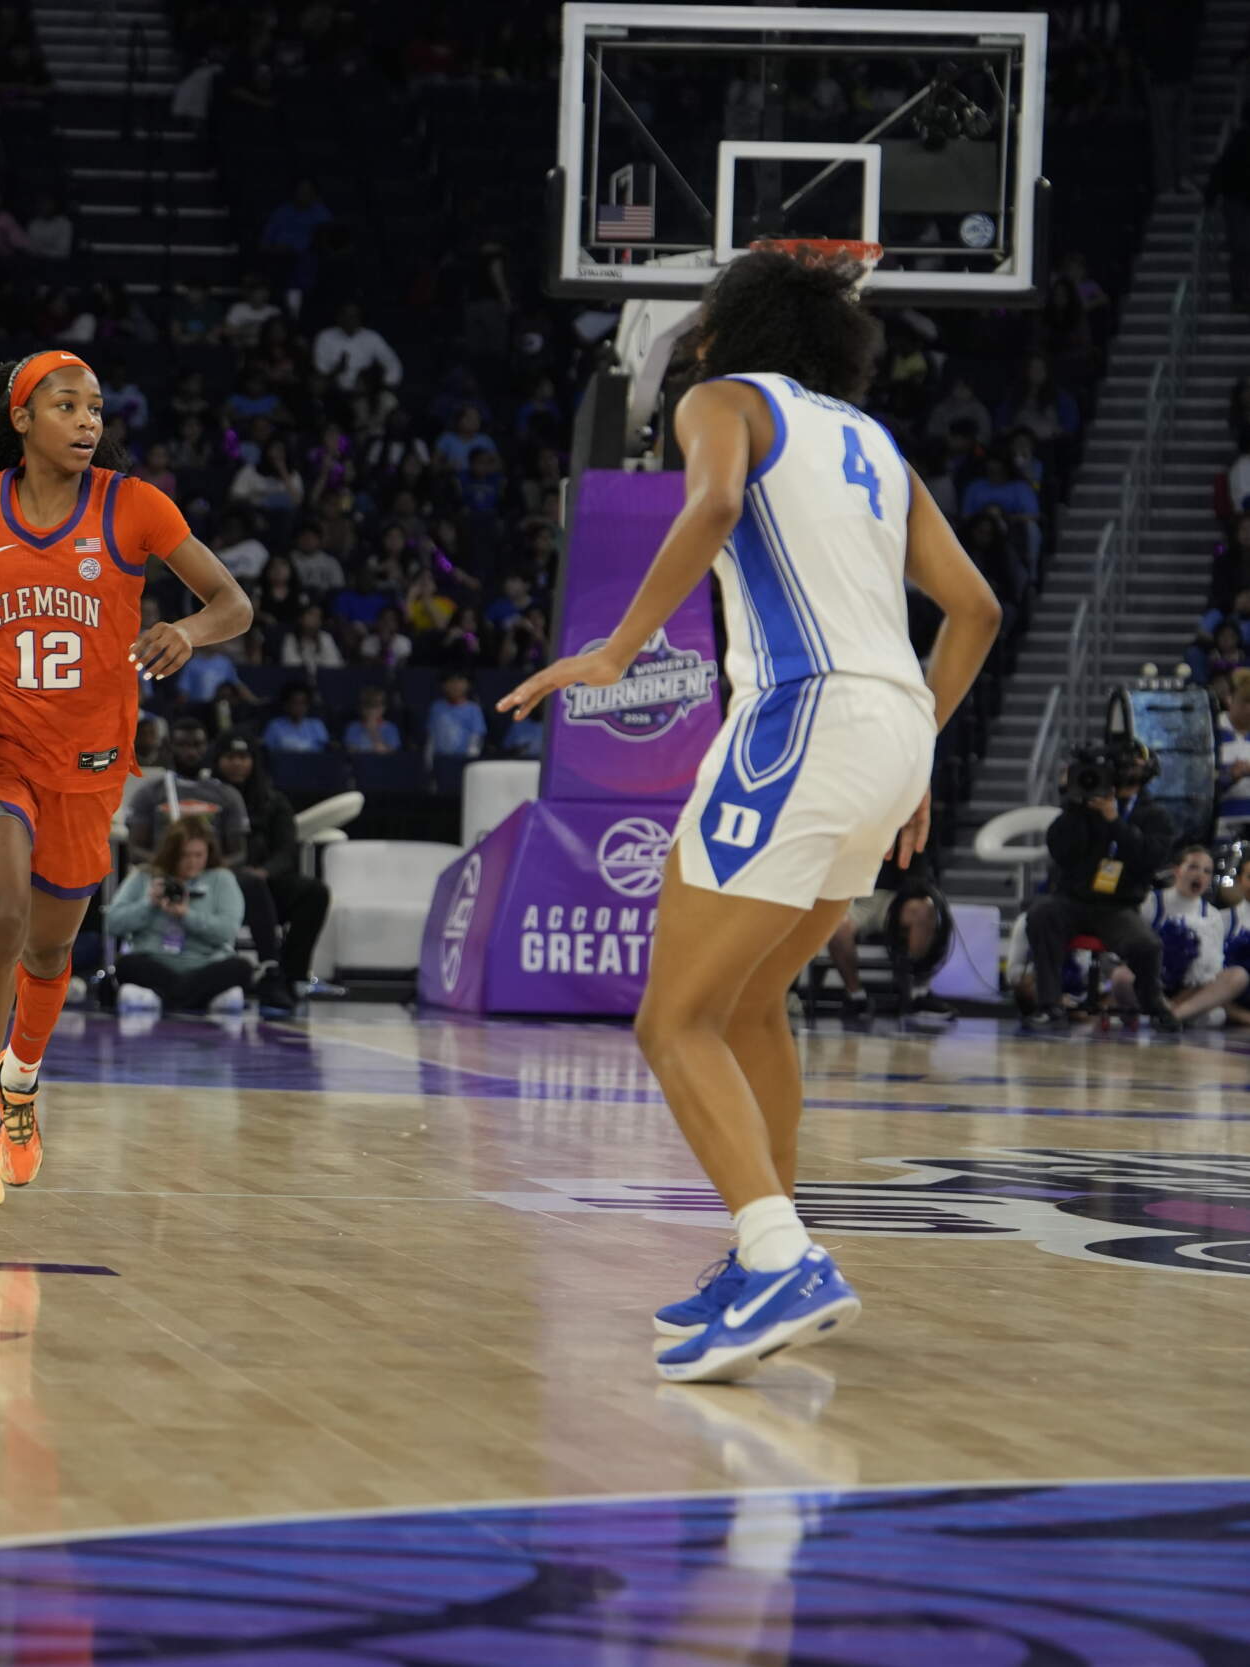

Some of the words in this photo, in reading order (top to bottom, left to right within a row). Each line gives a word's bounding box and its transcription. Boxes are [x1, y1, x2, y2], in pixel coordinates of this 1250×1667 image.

[842, 424, 883, 520] 4
[15, 630, 82, 689] 12
[569, 664, 715, 715] TOURNAMENT
[711, 802, 761, 849] D
[608, 842, 670, 860] ACC
[521, 934, 654, 975] GREAT
